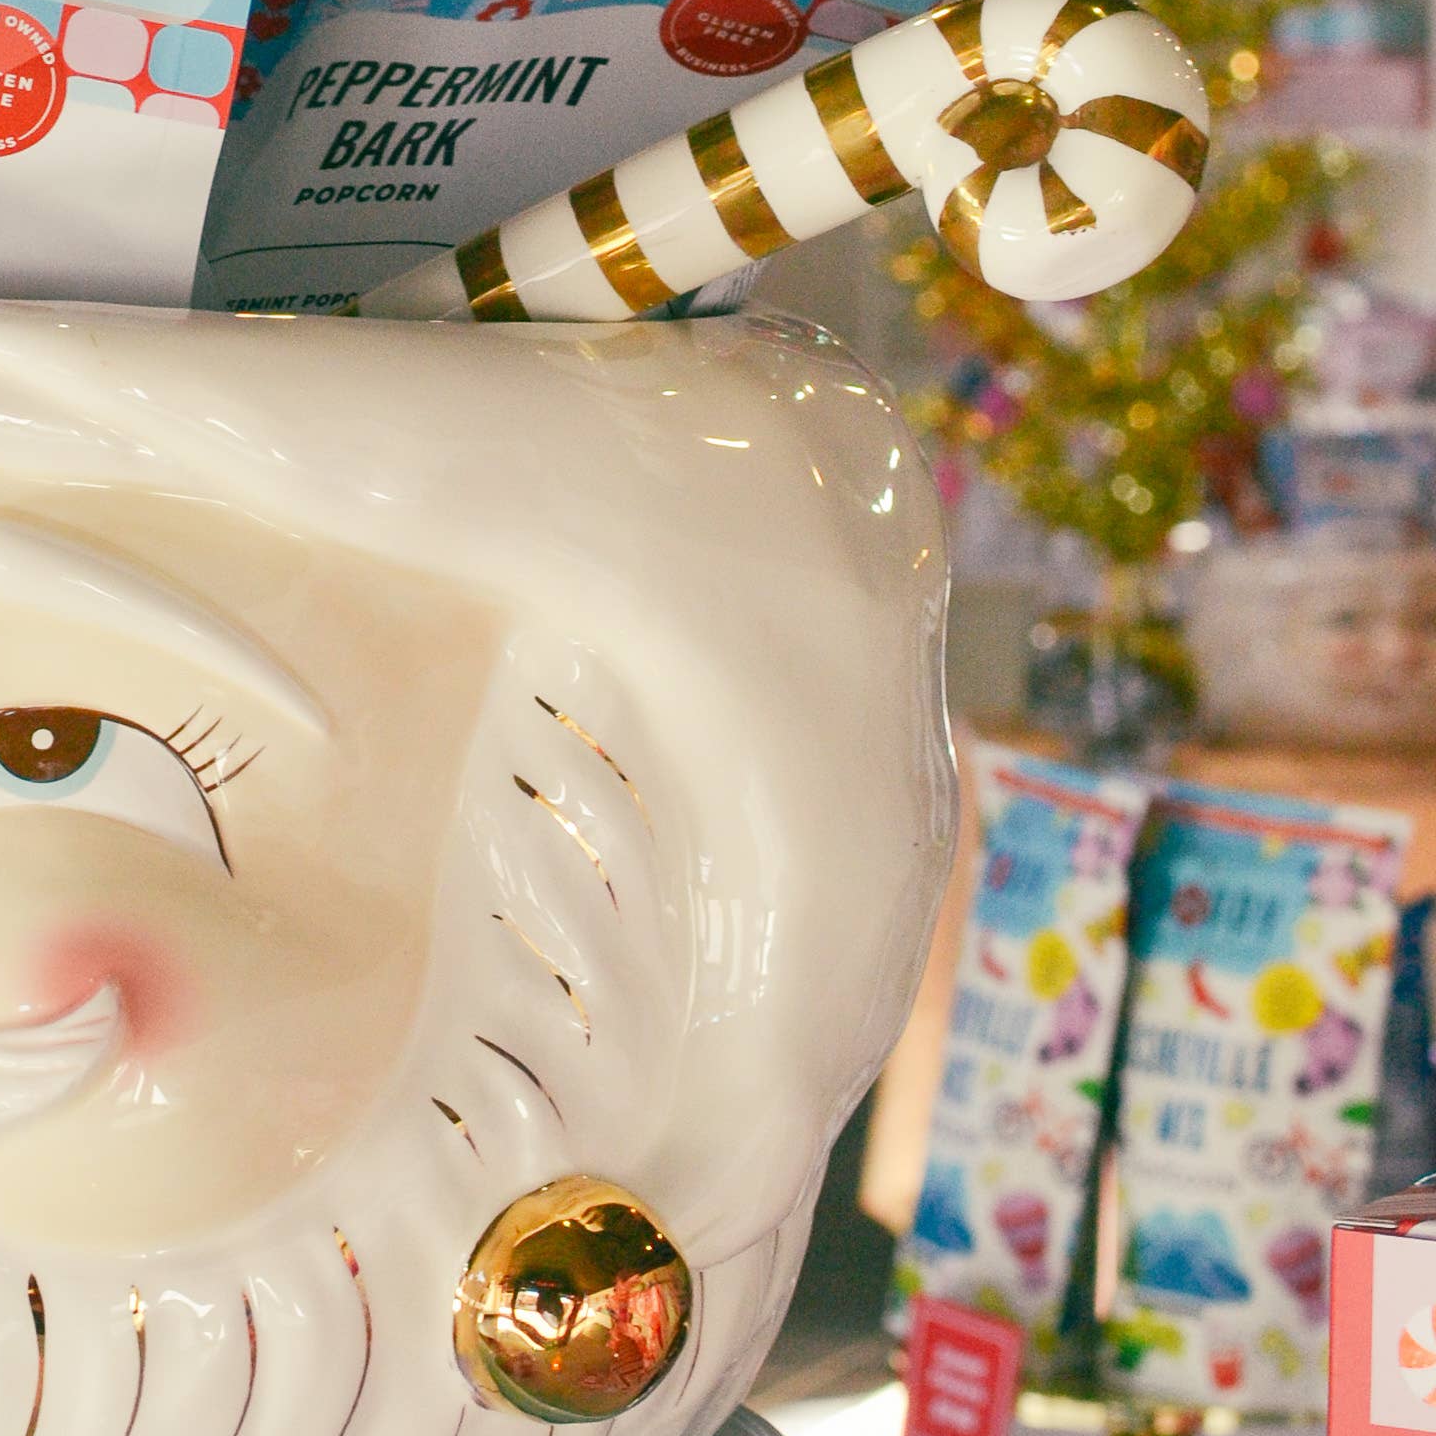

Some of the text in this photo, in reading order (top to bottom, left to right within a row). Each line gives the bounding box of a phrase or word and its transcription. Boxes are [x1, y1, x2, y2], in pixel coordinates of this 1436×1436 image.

[697, 11, 775, 39] GLUTEN
[702, 26, 755, 46] FREE
[4, 15, 56, 65] OWNED
[675, 46, 750, 73] BUSINESS
[285, 55, 611, 121] PEPPERMINT
[319, 117, 478, 171] BARK
[293, 183, 441, 207] POPCORN
